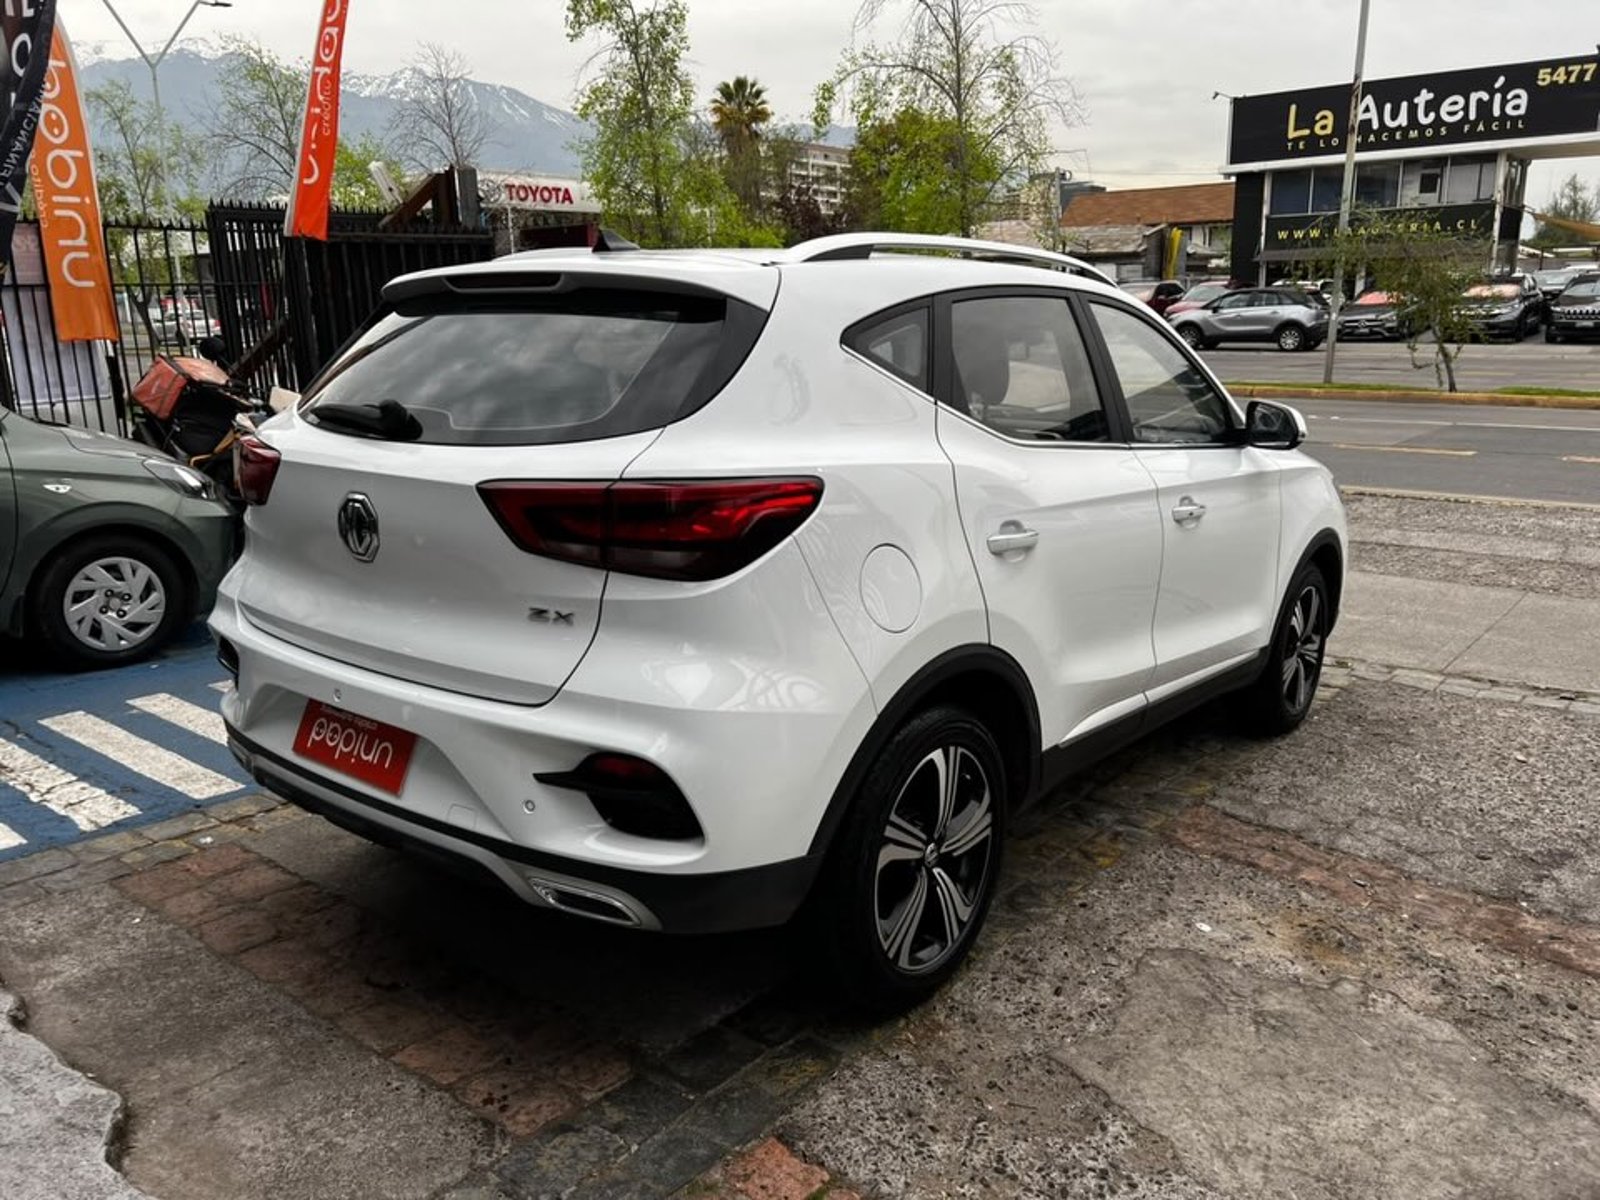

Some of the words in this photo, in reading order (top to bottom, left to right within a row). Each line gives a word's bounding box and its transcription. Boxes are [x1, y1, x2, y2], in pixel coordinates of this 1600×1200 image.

[1536, 63, 1598, 87] 5477
[1287, 103, 1335, 140] La
[1358, 75, 1529, 131] Autería
[1287, 141, 1305, 151] TE
[1319, 137, 1340, 148] LO
[1356, 126, 1448, 144] HACEMOS
[1463, 119, 1525, 134] FÁCIL
[505, 184, 574, 205] TOYOTA
[307, 718, 394, 769] unidad
